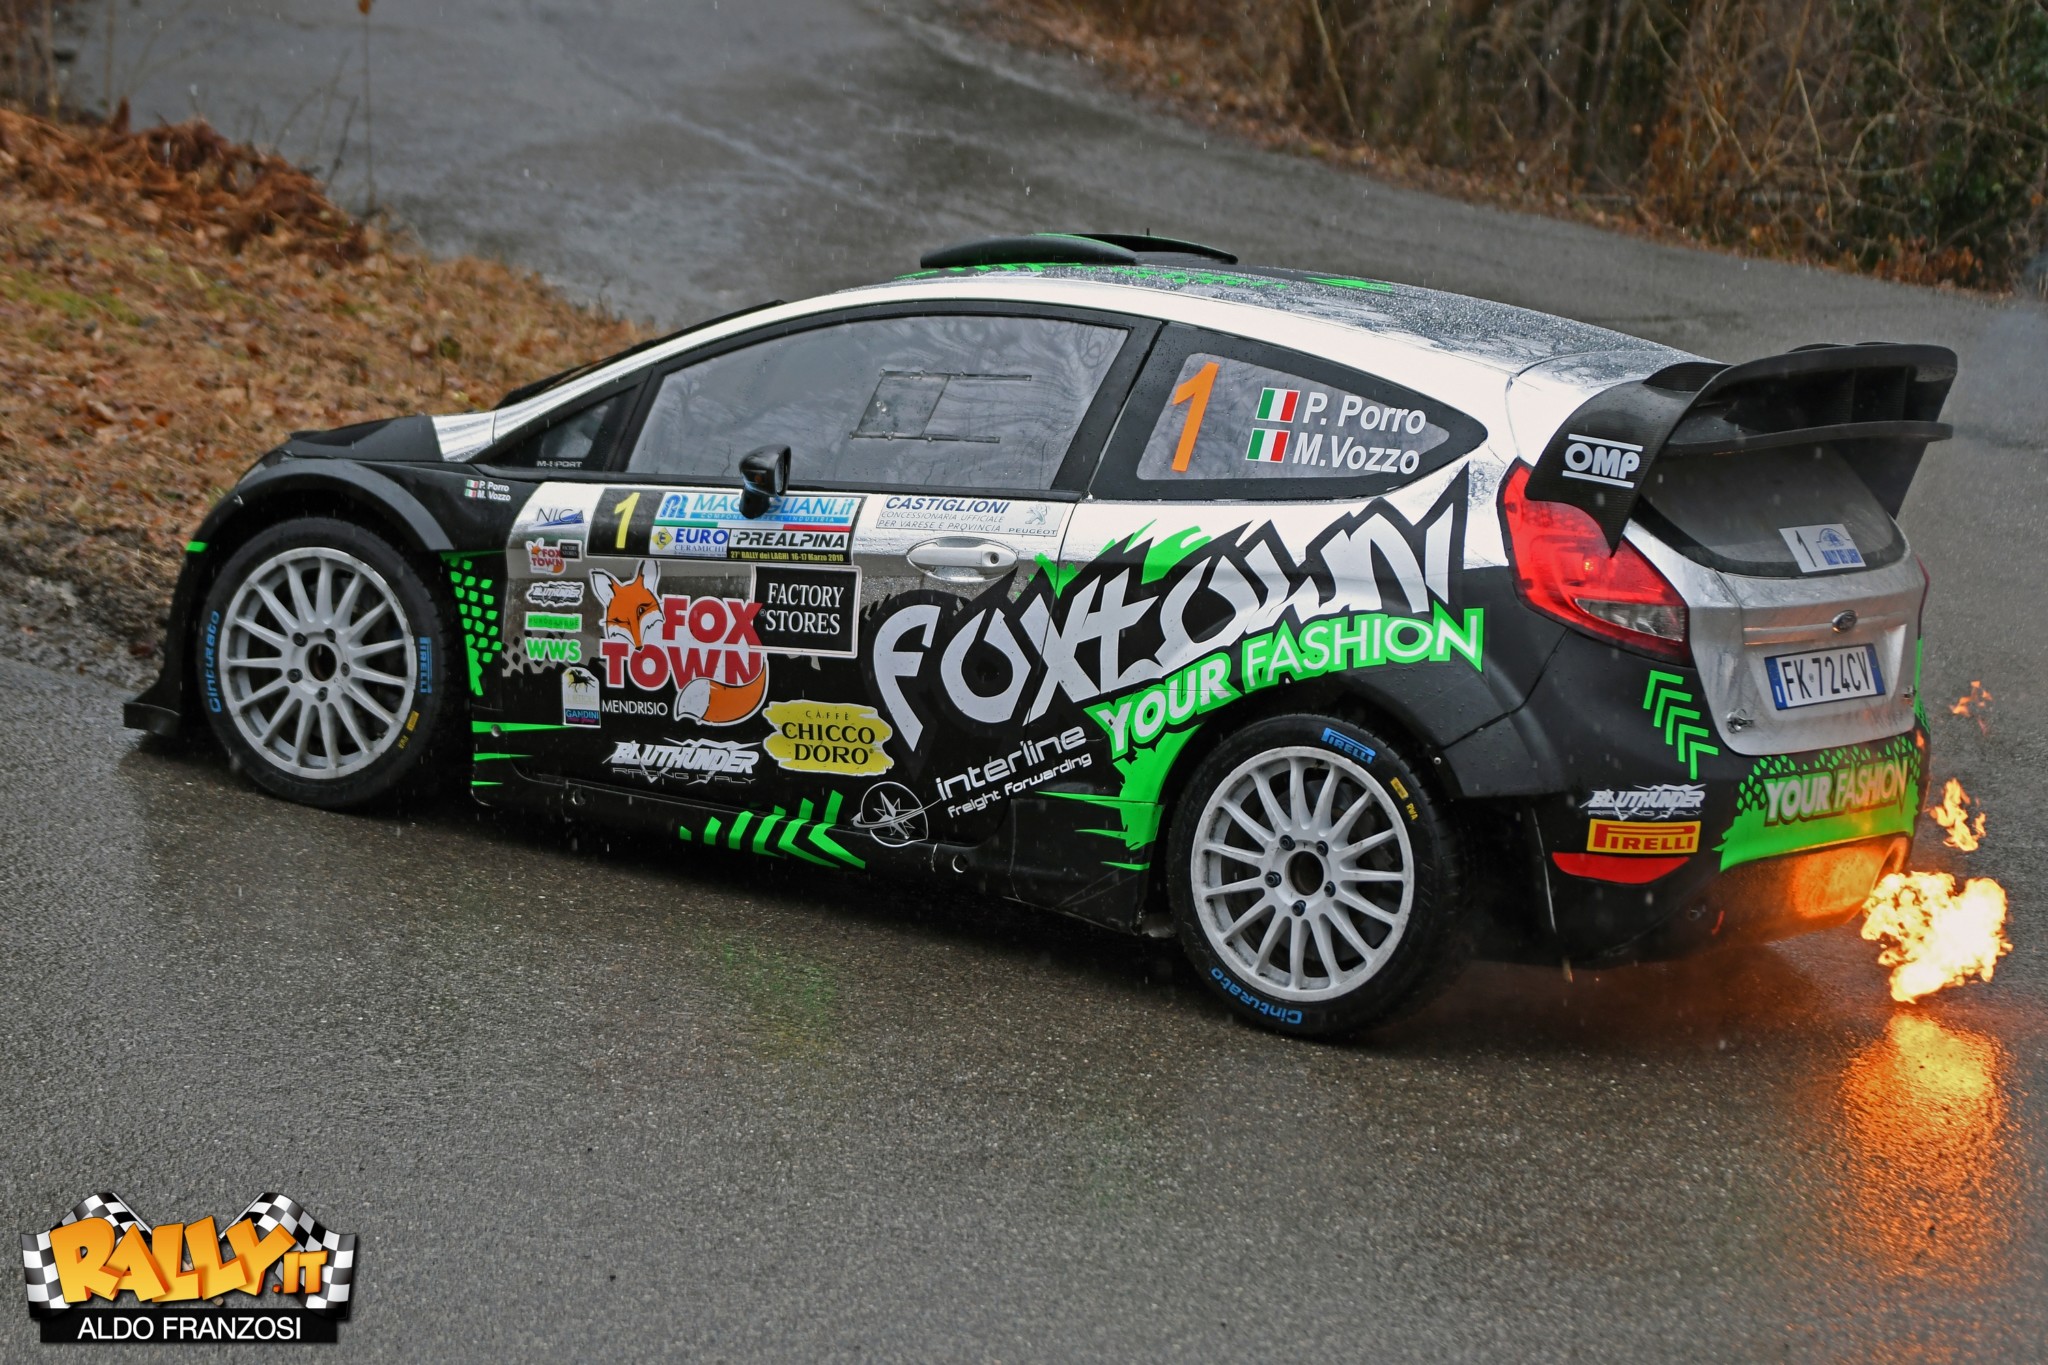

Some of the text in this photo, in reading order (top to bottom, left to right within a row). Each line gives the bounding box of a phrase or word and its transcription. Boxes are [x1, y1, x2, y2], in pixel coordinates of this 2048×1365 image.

[1172, 362, 1219, 472] 1
[1302, 391, 1427, 435] P. Porro
[1292, 431, 1420, 475] M.Vozzo
[1564, 442, 1641, 479] OMP
[476, 491, 512, 502] M. Vozzo
[478, 481, 510, 492] P. Porro
[536, 507, 585, 524] NICA
[881, 510, 1005, 523] CONCESSIONARIA UFFICIALE
[886, 496, 1011, 514] CASTIGLIONI
[613, 492, 641, 549] 1
[878, 519, 1001, 532] PER VARESE E PROVINCIA
[1008, 527, 1058, 535] PEUGEOT
[674, 543, 728, 553] CERAMICHE
[675, 528, 729, 545] EURO
[736, 531, 846, 548] PREALPINA
[531, 557, 563, 567] TOWN
[541, 548, 561, 558] FOX
[741, 550, 759, 560] RALLY
[759, 551, 770, 560] dei
[769, 551, 790, 561] LAGHI
[807, 553, 828, 562] Marzo
[767, 582, 844, 608] FACTORY
[662, 597, 763, 646] FOX
[765, 609, 840, 635] STORES
[526, 638, 581, 662] WWS
[419, 636, 433, 694] PIRELLI
[602, 642, 762, 690] TOWN
[1096, 612, 1478, 753] YOUR FASHION
[565, 709, 599, 719] GANDINI
[601, 699, 668, 716] MENDRISIO
[781, 721, 876, 745] CHICCO
[610, 741, 760, 774] BLUTHUNDER
[794, 743, 869, 765] D'ORO
[1320, 726, 1377, 765] PIRELLI
[935, 726, 1087, 801] interline
[1587, 789, 1706, 808] BLUTHUNDER
[1766, 758, 1909, 819] YOUR FASHION
[1593, 822, 1696, 851] PIRELLI
[1210, 965, 1303, 1025] Cinturato
